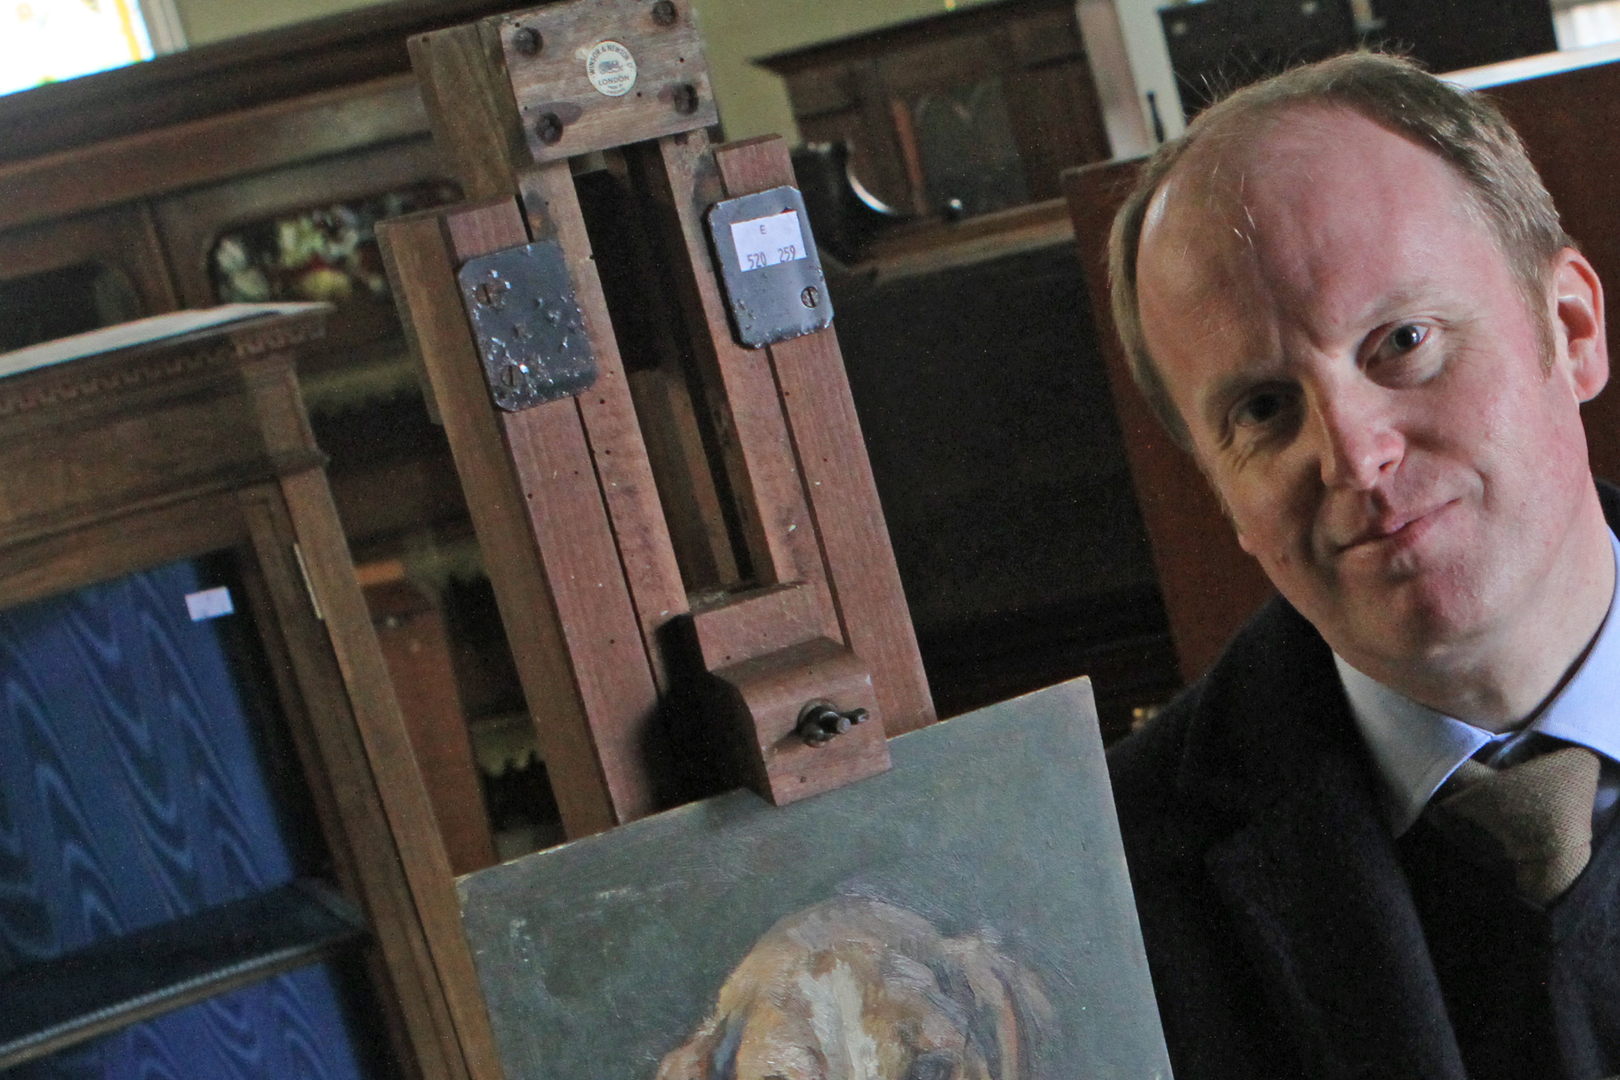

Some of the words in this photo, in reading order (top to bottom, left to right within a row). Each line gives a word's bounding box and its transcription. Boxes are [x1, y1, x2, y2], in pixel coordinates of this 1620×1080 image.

[589, 48, 601, 76] WINSOR
[607, 44, 630, 61] NEWTON
[598, 75, 630, 86] LONDON
[759, 224, 767, 235] E
[747, 252, 767, 270] 520
[778, 245, 796, 263] 259
